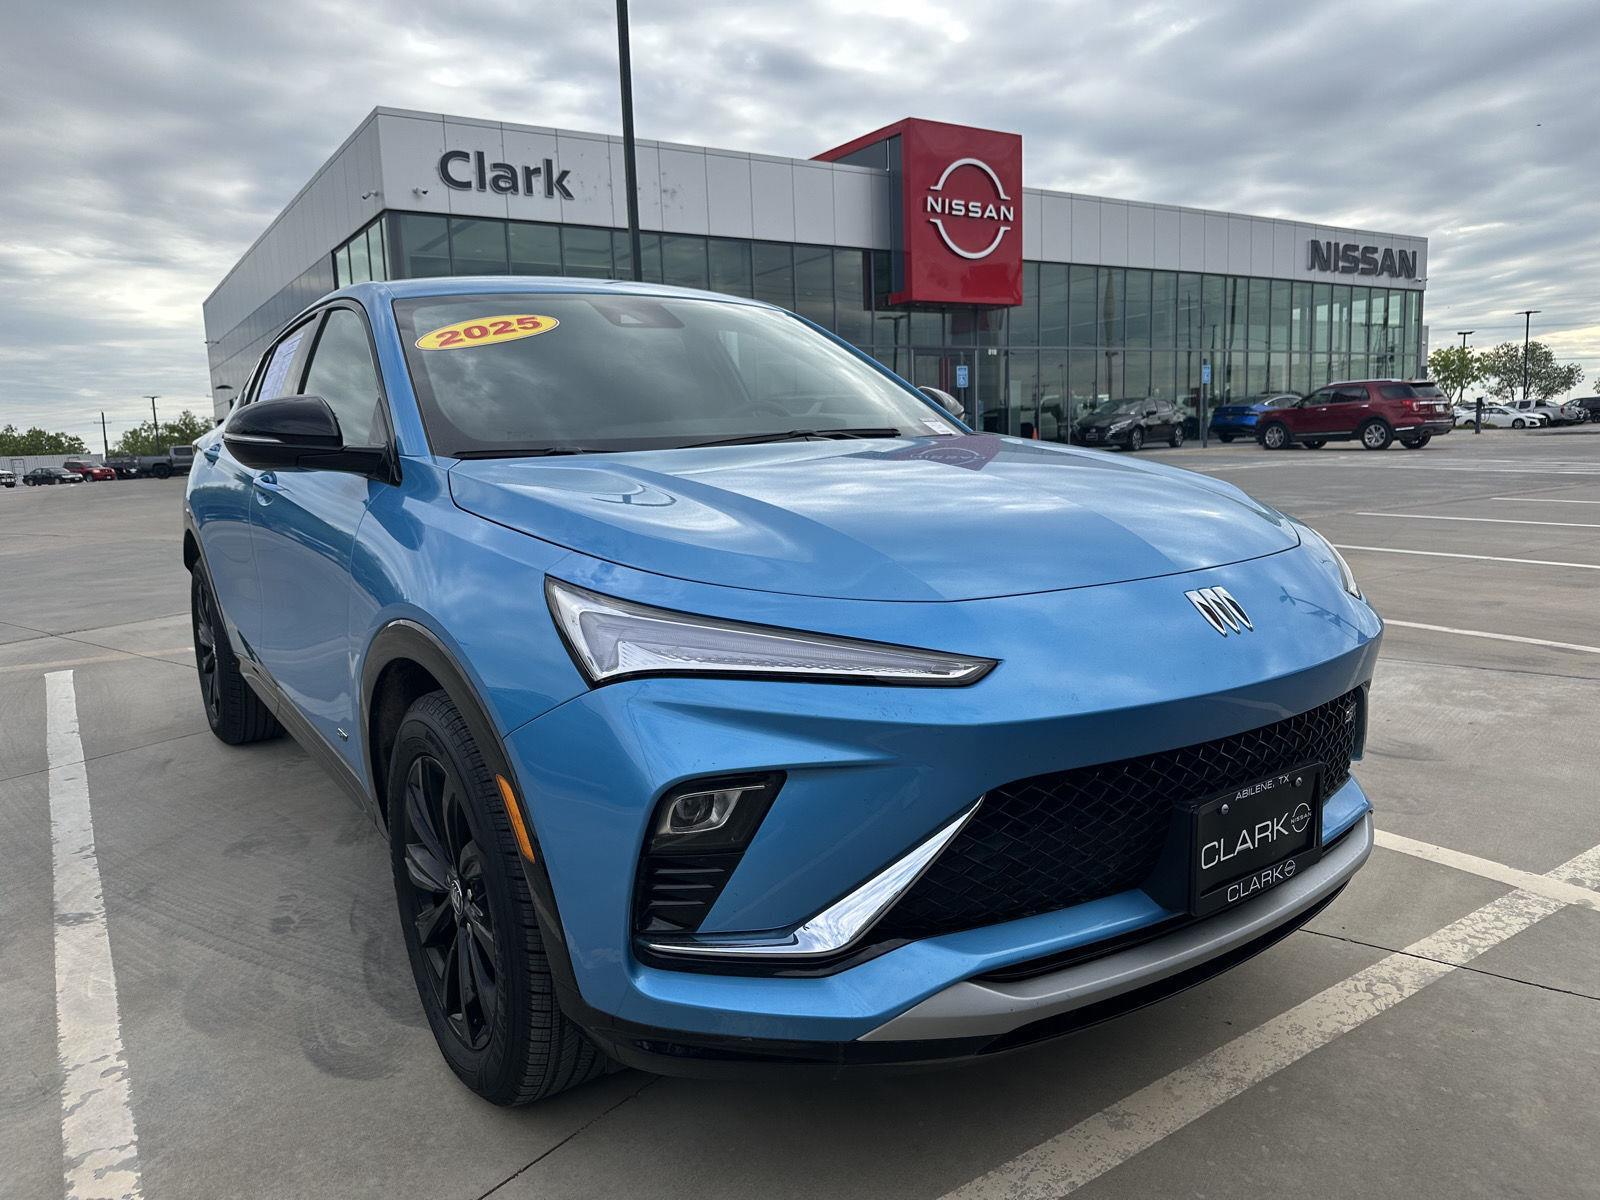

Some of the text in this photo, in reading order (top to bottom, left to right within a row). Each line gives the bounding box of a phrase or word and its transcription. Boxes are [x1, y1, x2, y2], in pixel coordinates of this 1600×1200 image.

[438, 150, 575, 201] Clark
[927, 196, 1014, 222] NISSAN
[1307, 239, 1417, 279] NISSAN
[436, 316, 542, 347] 2025
[1235, 774, 1290, 800] ABILENE, TX
[1201, 811, 1312, 870] CLARK NISSAN
[1227, 864, 1284, 902] CLARK
